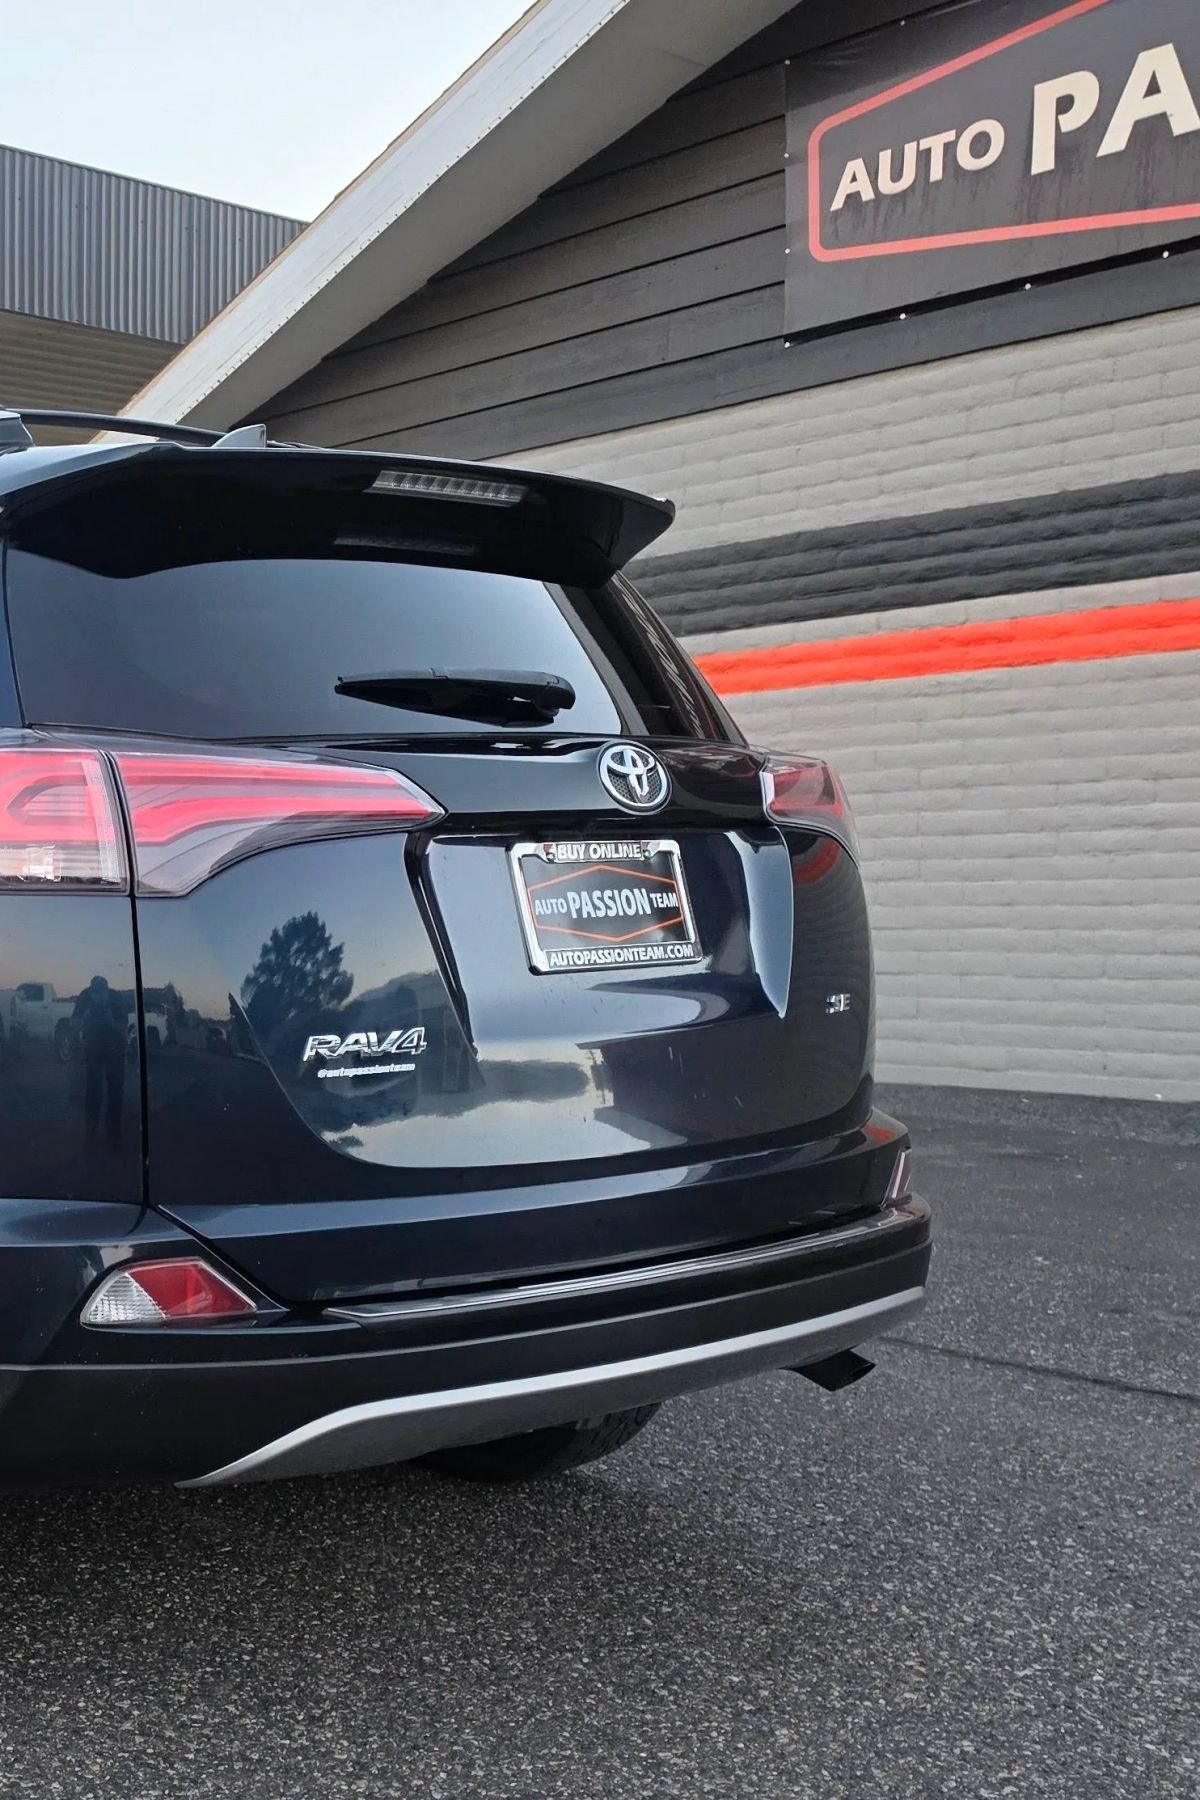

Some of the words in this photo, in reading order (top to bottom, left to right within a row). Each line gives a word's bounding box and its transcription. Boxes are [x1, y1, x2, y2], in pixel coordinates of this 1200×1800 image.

[829, 118, 1005, 213] AUTO
[1030, 42, 1200, 177] PA
[557, 843, 586, 860] BUY
[589, 842, 642, 859] ONLINE
[535, 898, 568, 916] AUTO
[567, 887, 652, 919] PASSION
[651, 892, 679, 909] TEAM
[550, 944, 694, 968] AUTOPASSIONTEAM.COM
[302, 1026, 428, 1062] RAV4
